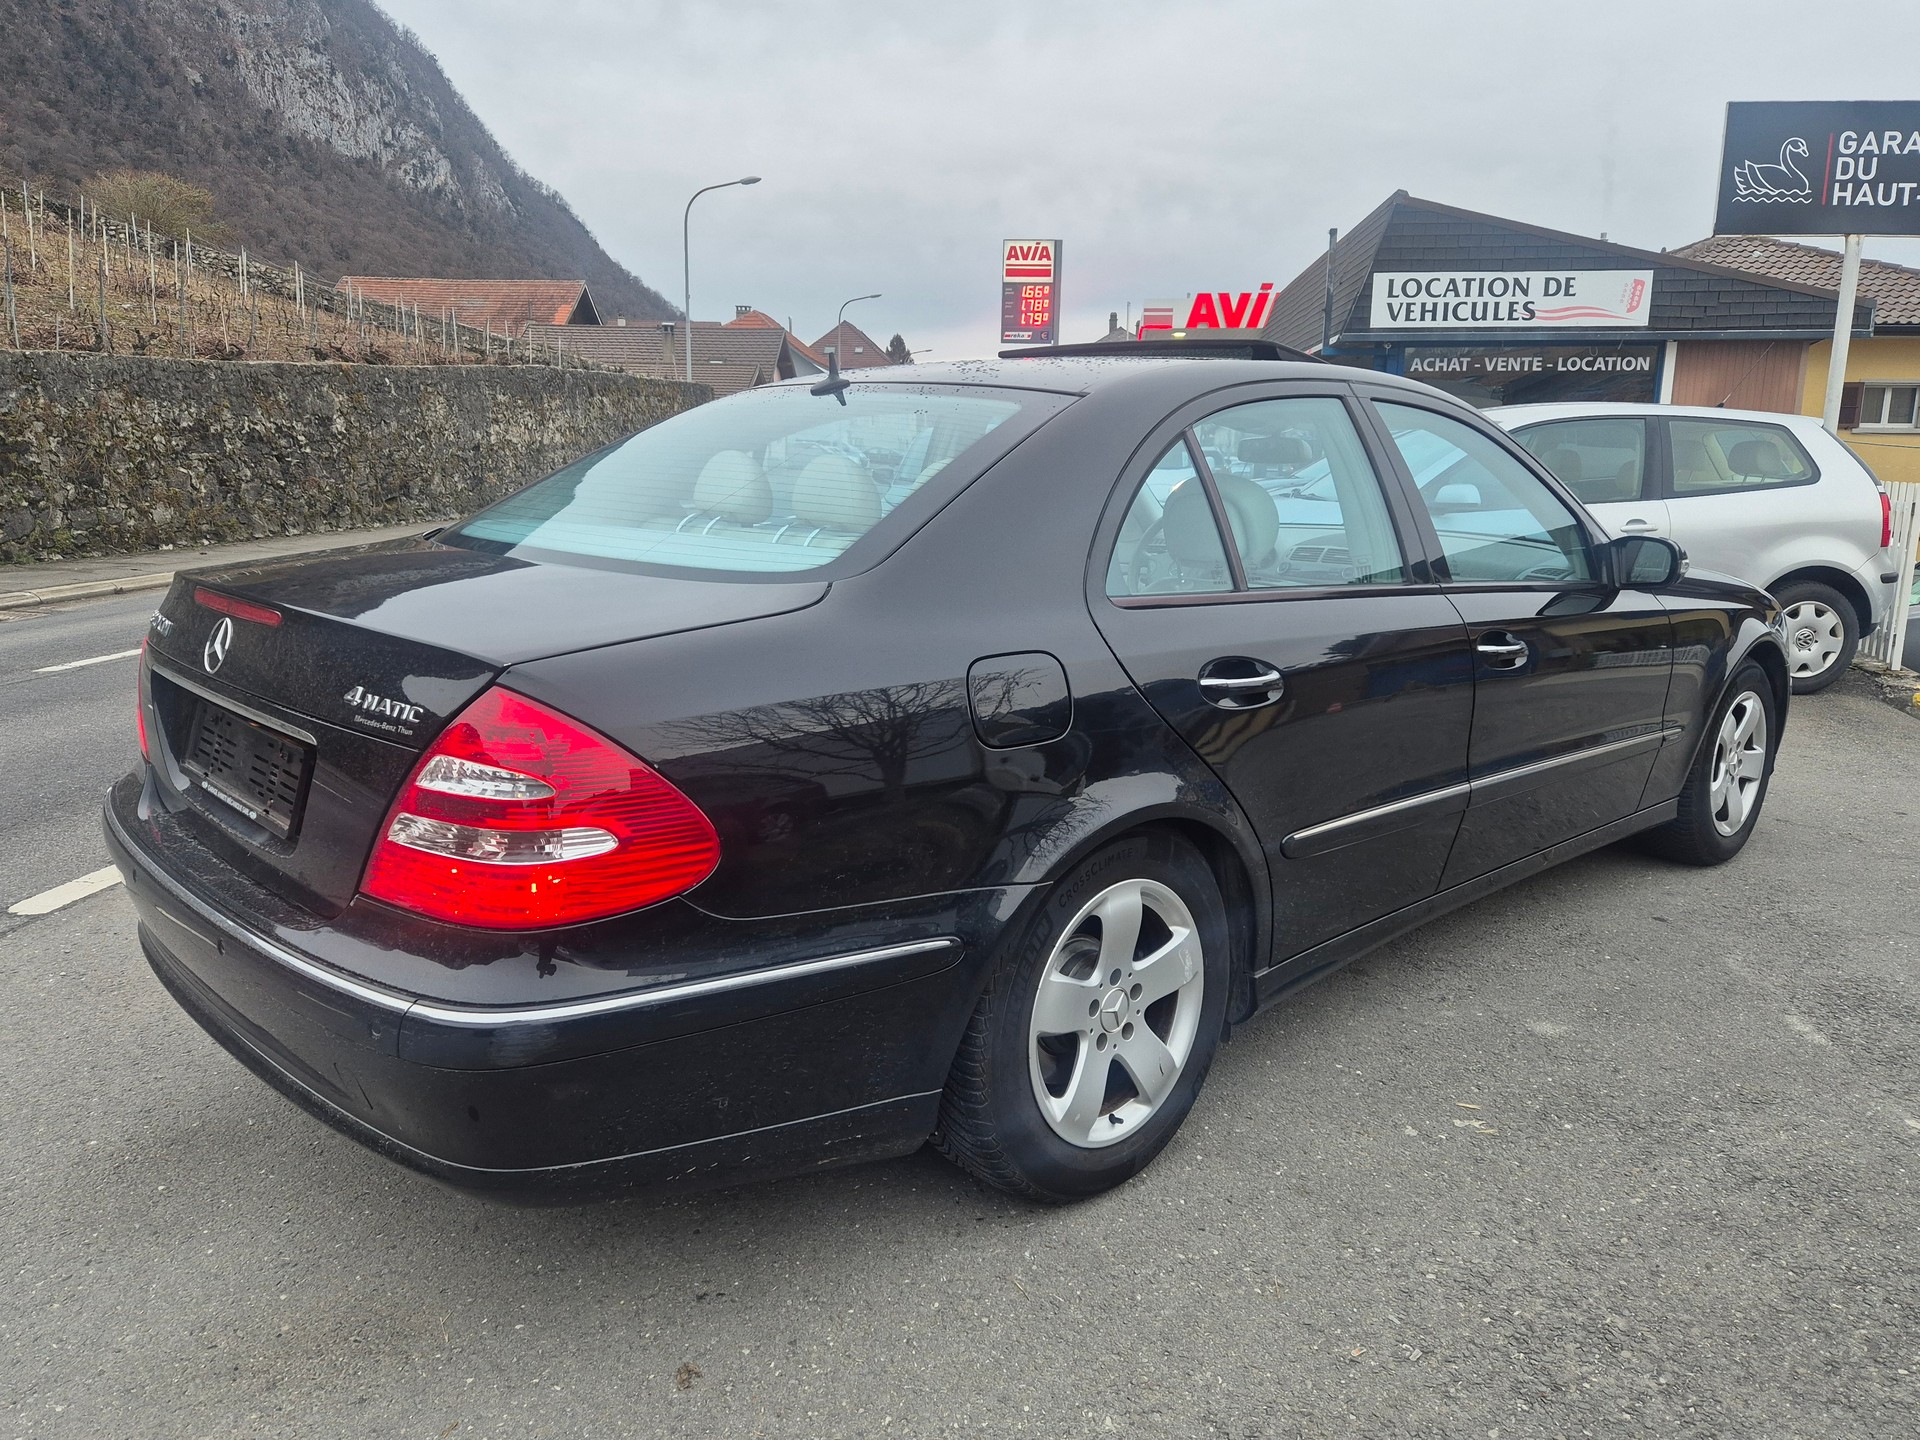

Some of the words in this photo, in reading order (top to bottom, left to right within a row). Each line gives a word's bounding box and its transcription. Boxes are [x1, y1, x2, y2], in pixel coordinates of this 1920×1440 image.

[1835, 157, 1878, 181] DU
[1386, 277, 1531, 299] LOCATION
[1542, 276, 1577, 297] DE
[1186, 283, 1280, 328] AVI
[1386, 301, 1536, 322] VEHICULES
[1410, 358, 1471, 371] ACHAT
[1485, 357, 1543, 371] VENTE
[1557, 356, 1651, 371] LOCATION
[354, 714, 397, 732] Mercedes-Benz
